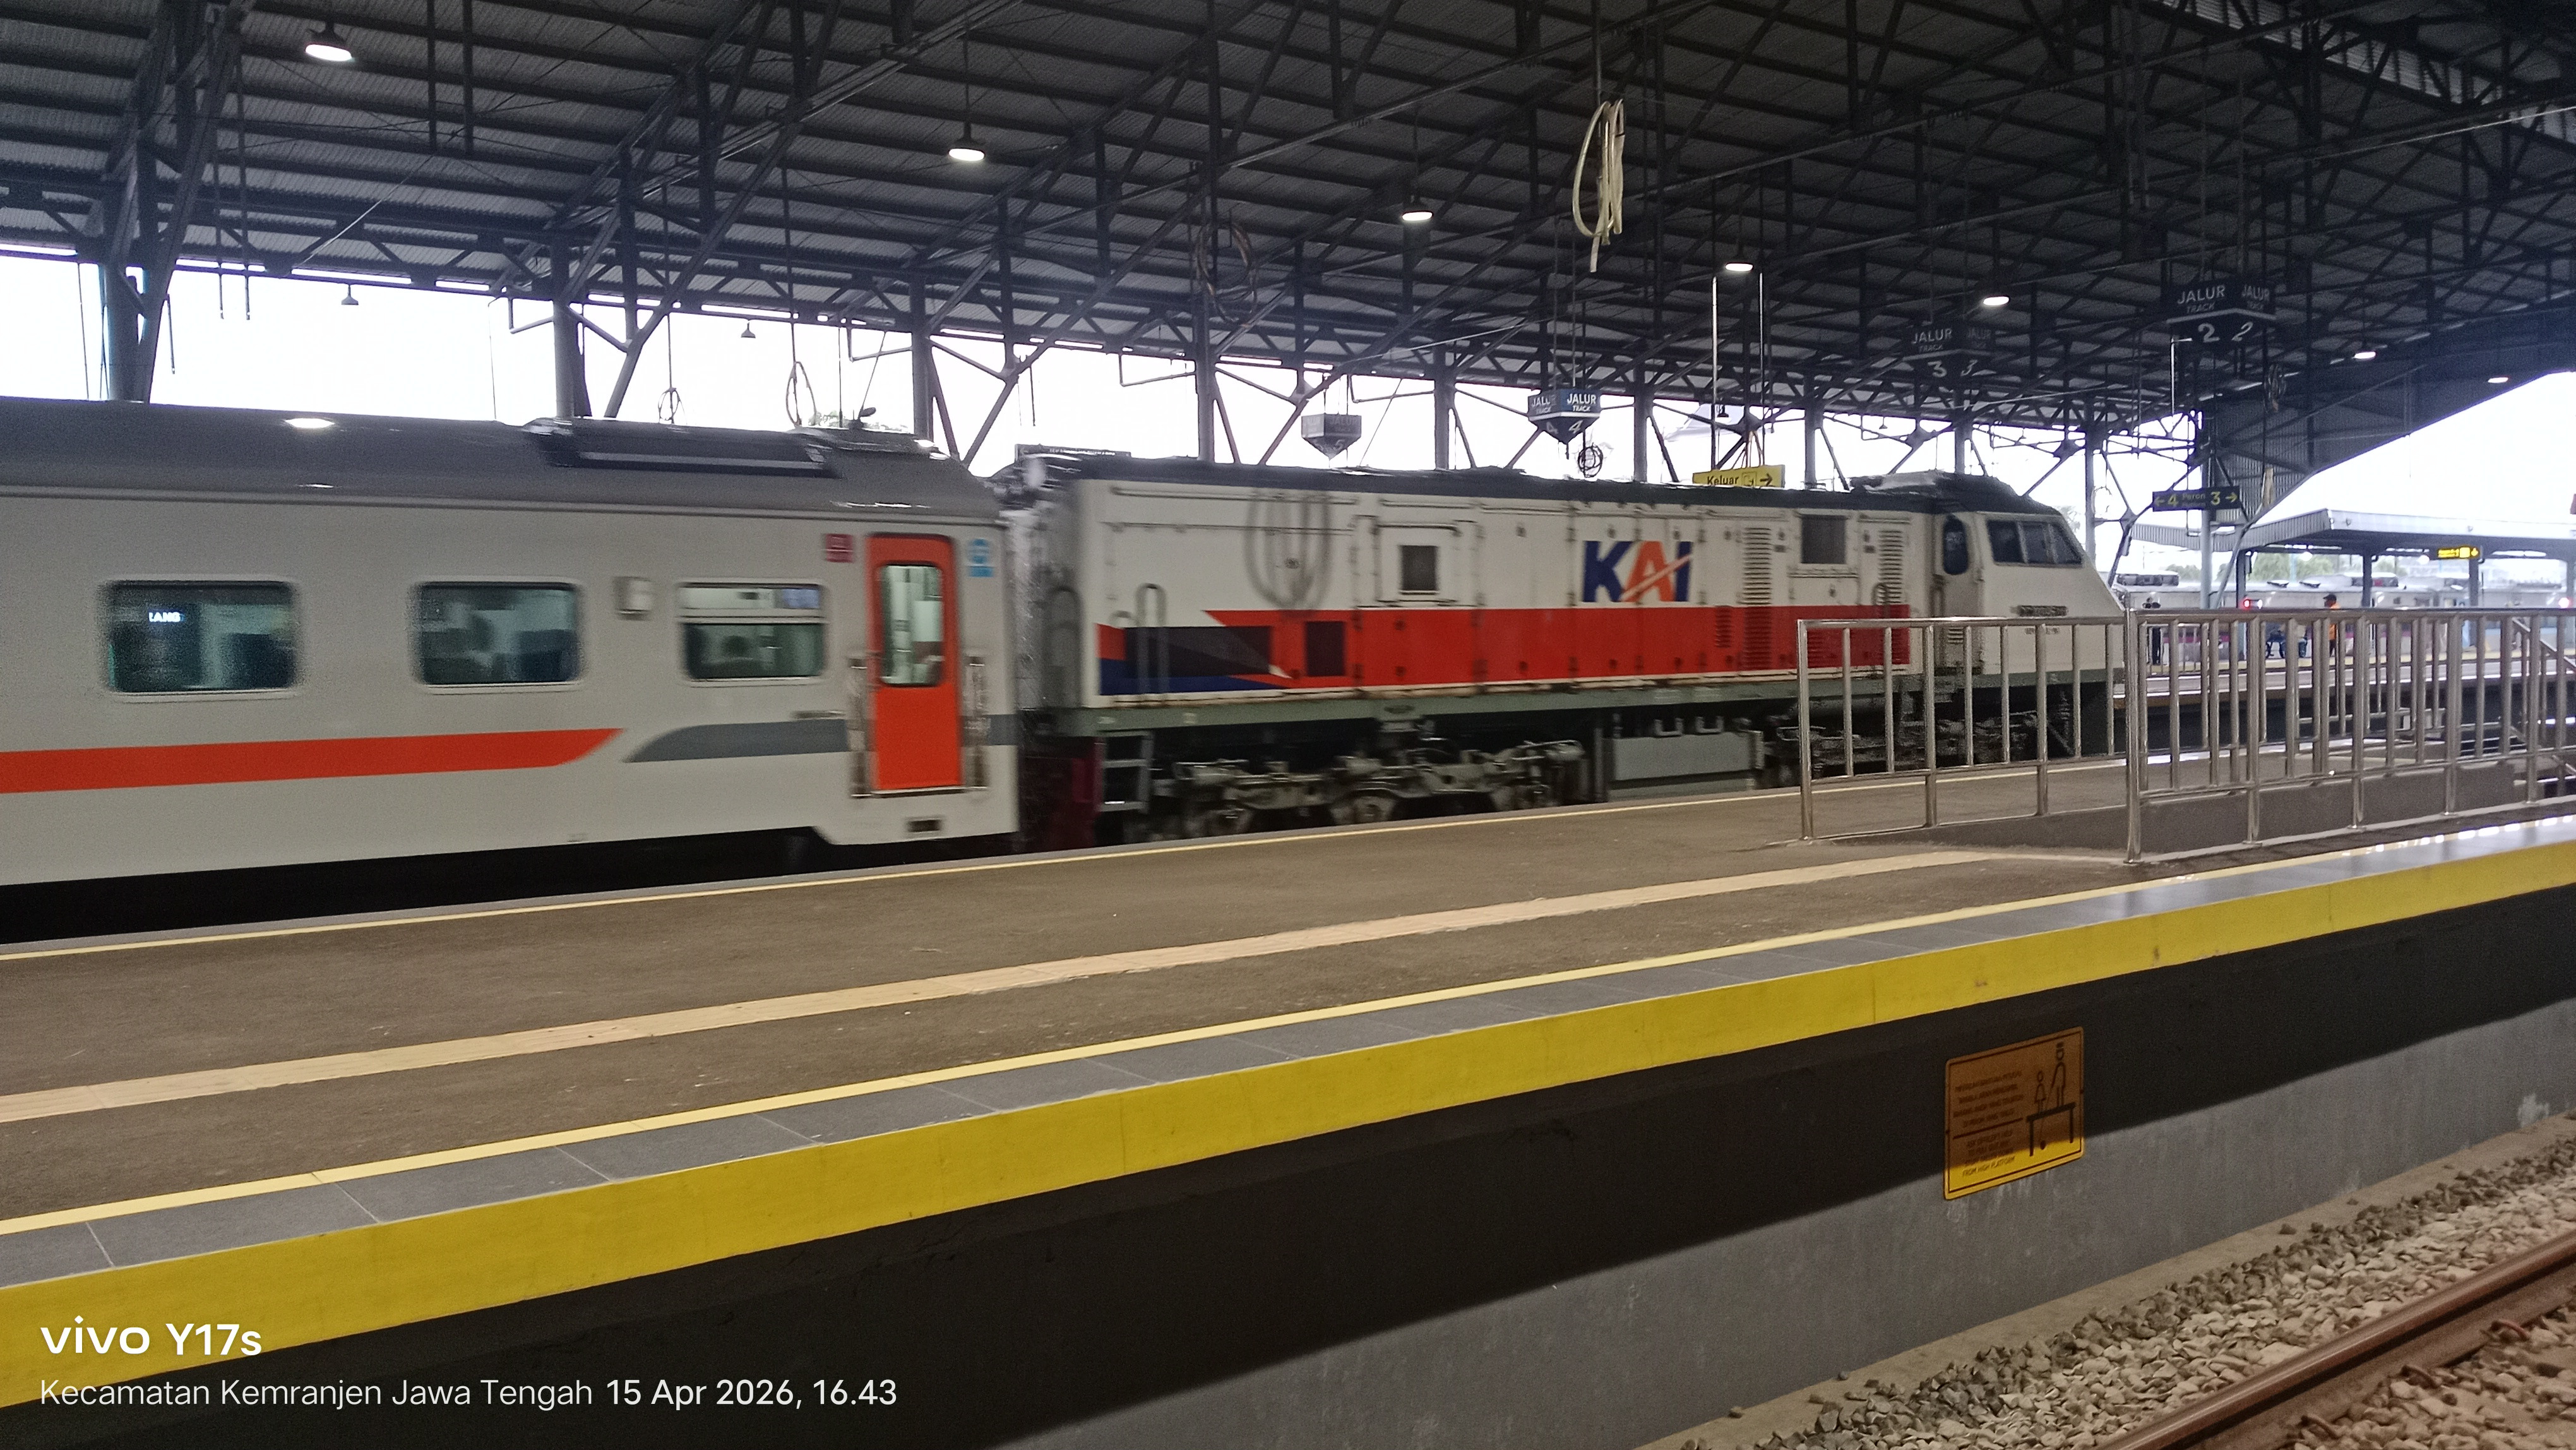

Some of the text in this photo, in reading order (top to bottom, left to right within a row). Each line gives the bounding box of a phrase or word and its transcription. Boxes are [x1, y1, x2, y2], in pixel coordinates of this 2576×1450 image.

[2177, 285, 2226, 304] JALUR
[1911, 328, 1952, 345] JALUR
[2198, 323, 2220, 343] 2
[2231, 321, 2253, 342] 2
[1928, 360, 1947, 378] 3
[1566, 393, 1597, 405] JALUR
[1568, 420, 1583, 434] 4
[1707, 474, 1739, 485] Keluar
[2168, 493, 2179, 507] 4
[2210, 491, 2221, 506] 3
[1582, 540, 1693, 602] KAI
